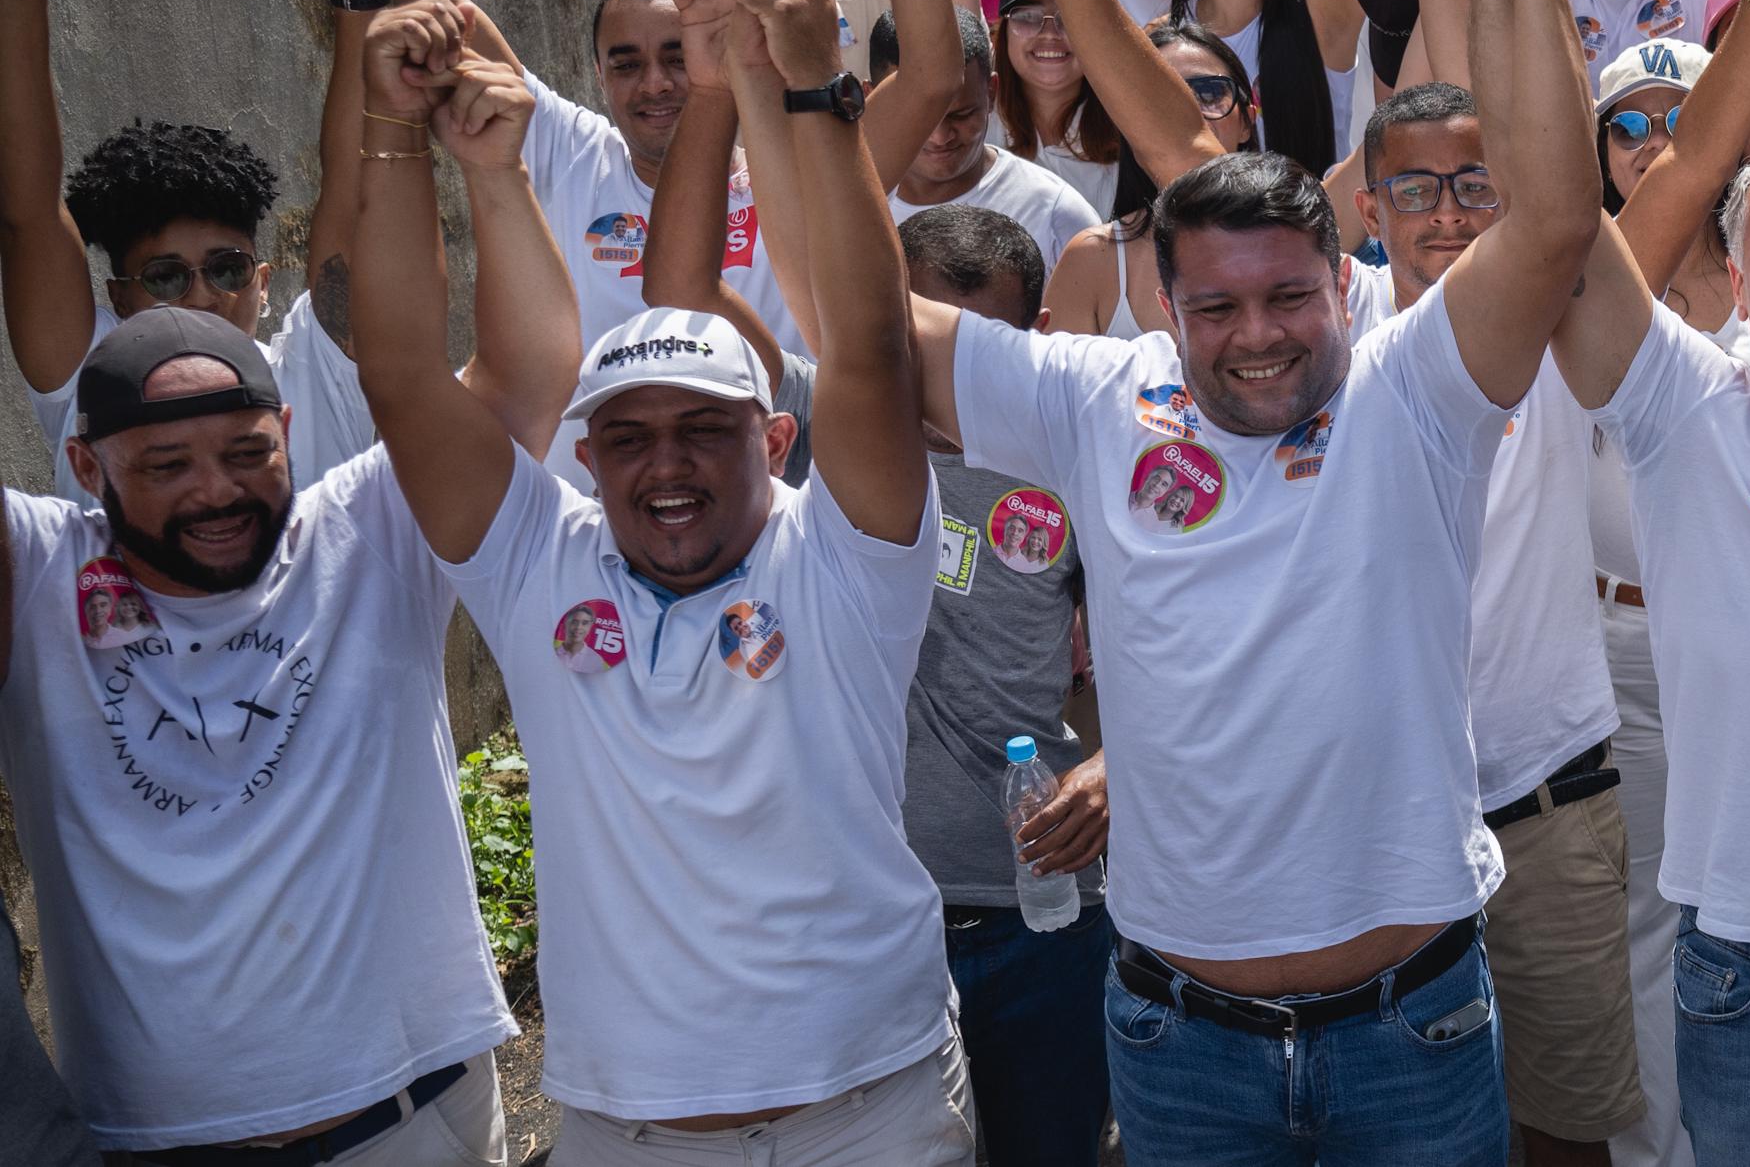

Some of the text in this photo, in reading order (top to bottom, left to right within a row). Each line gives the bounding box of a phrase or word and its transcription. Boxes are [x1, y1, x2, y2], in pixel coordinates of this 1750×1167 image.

[598, 248, 634, 261] 15151
[597, 335, 697, 372] Alexandre
[618, 351, 673, 369] AYRES
[1291, 459, 1322, 477] 1515
[1198, 472, 1220, 495] 15
[1007, 495, 1047, 520] RAFAEL
[1045, 509, 1062, 528] 15
[958, 537, 976, 581] MANPHIL
[592, 628, 624, 654] 15
[759, 618, 783, 643] Pierre
